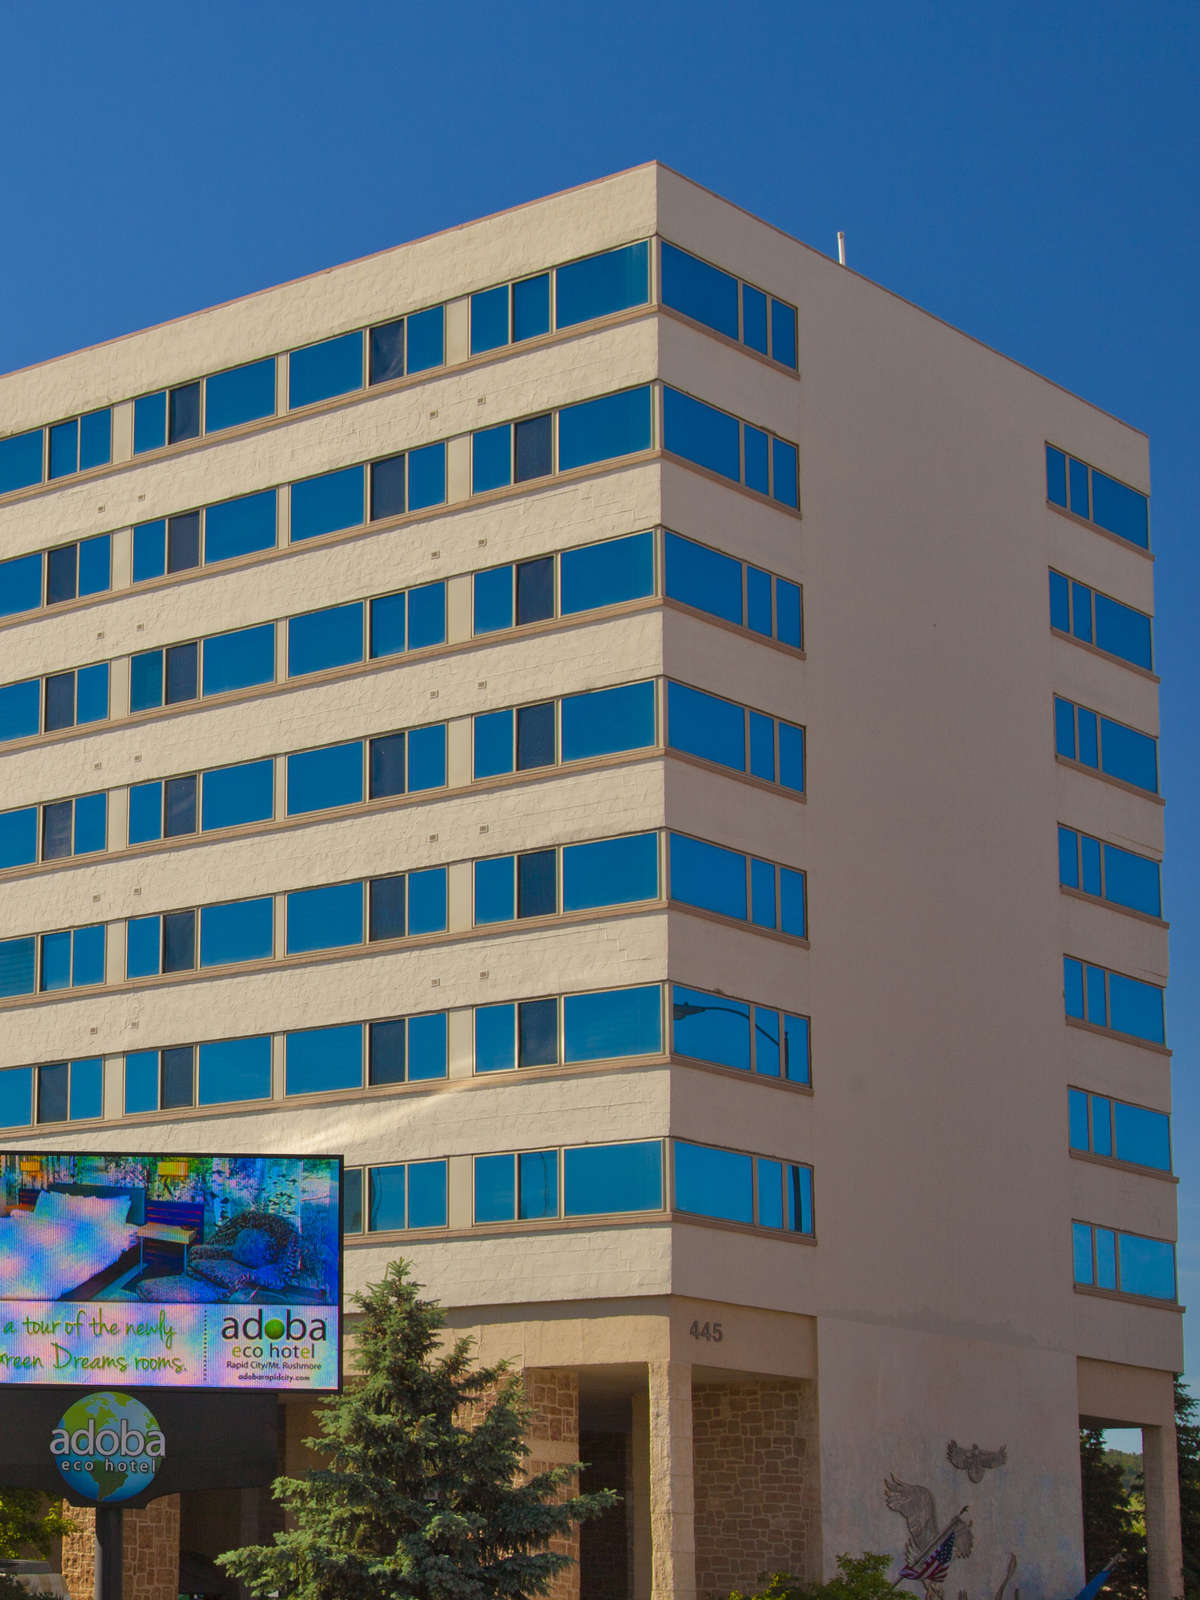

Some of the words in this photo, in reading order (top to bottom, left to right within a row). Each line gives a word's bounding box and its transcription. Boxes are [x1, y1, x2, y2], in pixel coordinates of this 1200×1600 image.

[2, 1321, 17, 1335] a
[22, 1315, 61, 1336] tour
[64, 1309, 86, 1336] of
[89, 1307, 120, 1337] the
[126, 1309, 176, 1350] newly
[221, 1308, 327, 1341] adoba
[689, 1320, 723, 1342] 445
[51, 1341, 128, 1373] Dreams
[134, 1356, 188, 1374] rooms.
[232, 1345, 263, 1358] eco
[269, 1342, 315, 1359] hotel
[226, 1360, 249, 1370] Rapid
[282, 1361, 322, 1371] Rushmore
[49, 1418, 167, 1457] adoba
[61, 1460, 94, 1471] eco
[105, 1458, 156, 1473] hotel
